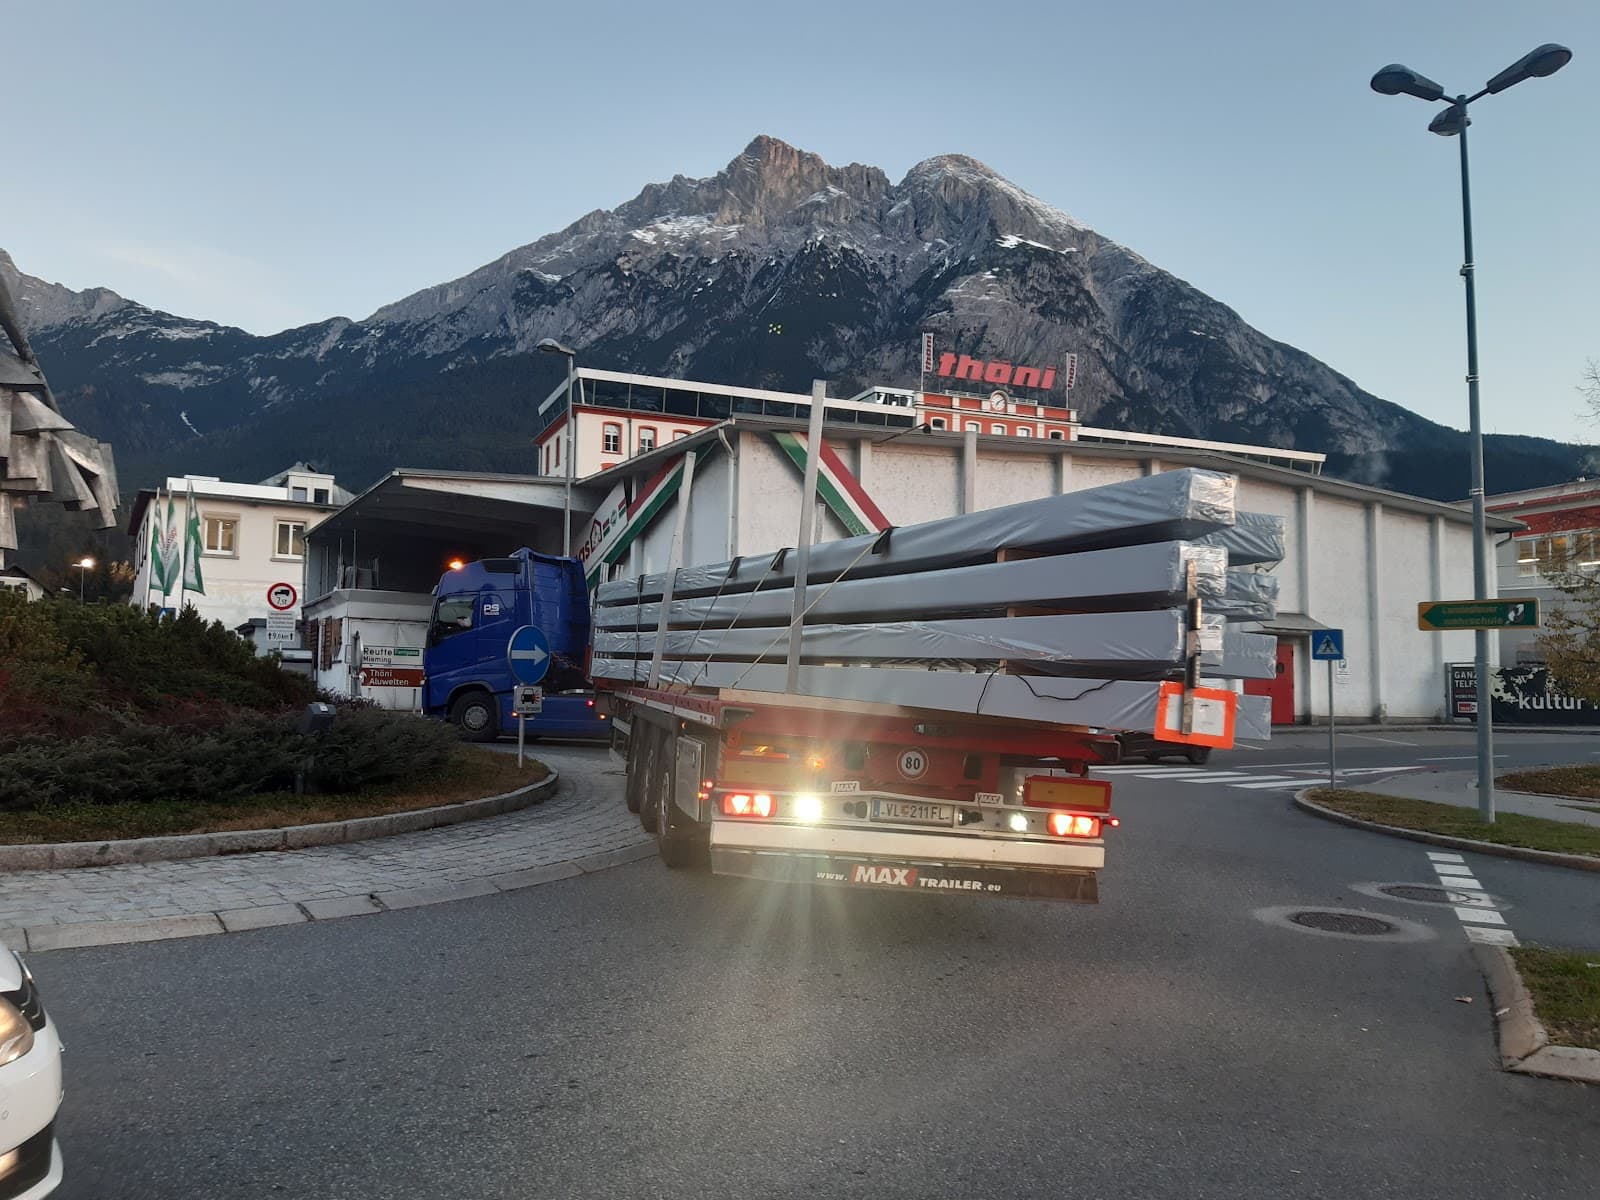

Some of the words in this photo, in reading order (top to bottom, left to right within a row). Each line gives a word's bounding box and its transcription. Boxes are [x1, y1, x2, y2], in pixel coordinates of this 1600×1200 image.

[938, 352, 1057, 390] thöni
[370, 669, 393, 678] Thöni
[370, 677, 409, 686] Aluwelten
[1519, 690, 1586, 710] kultur
[905, 756, 920, 770] 80
[855, 866, 910, 886] MAX
